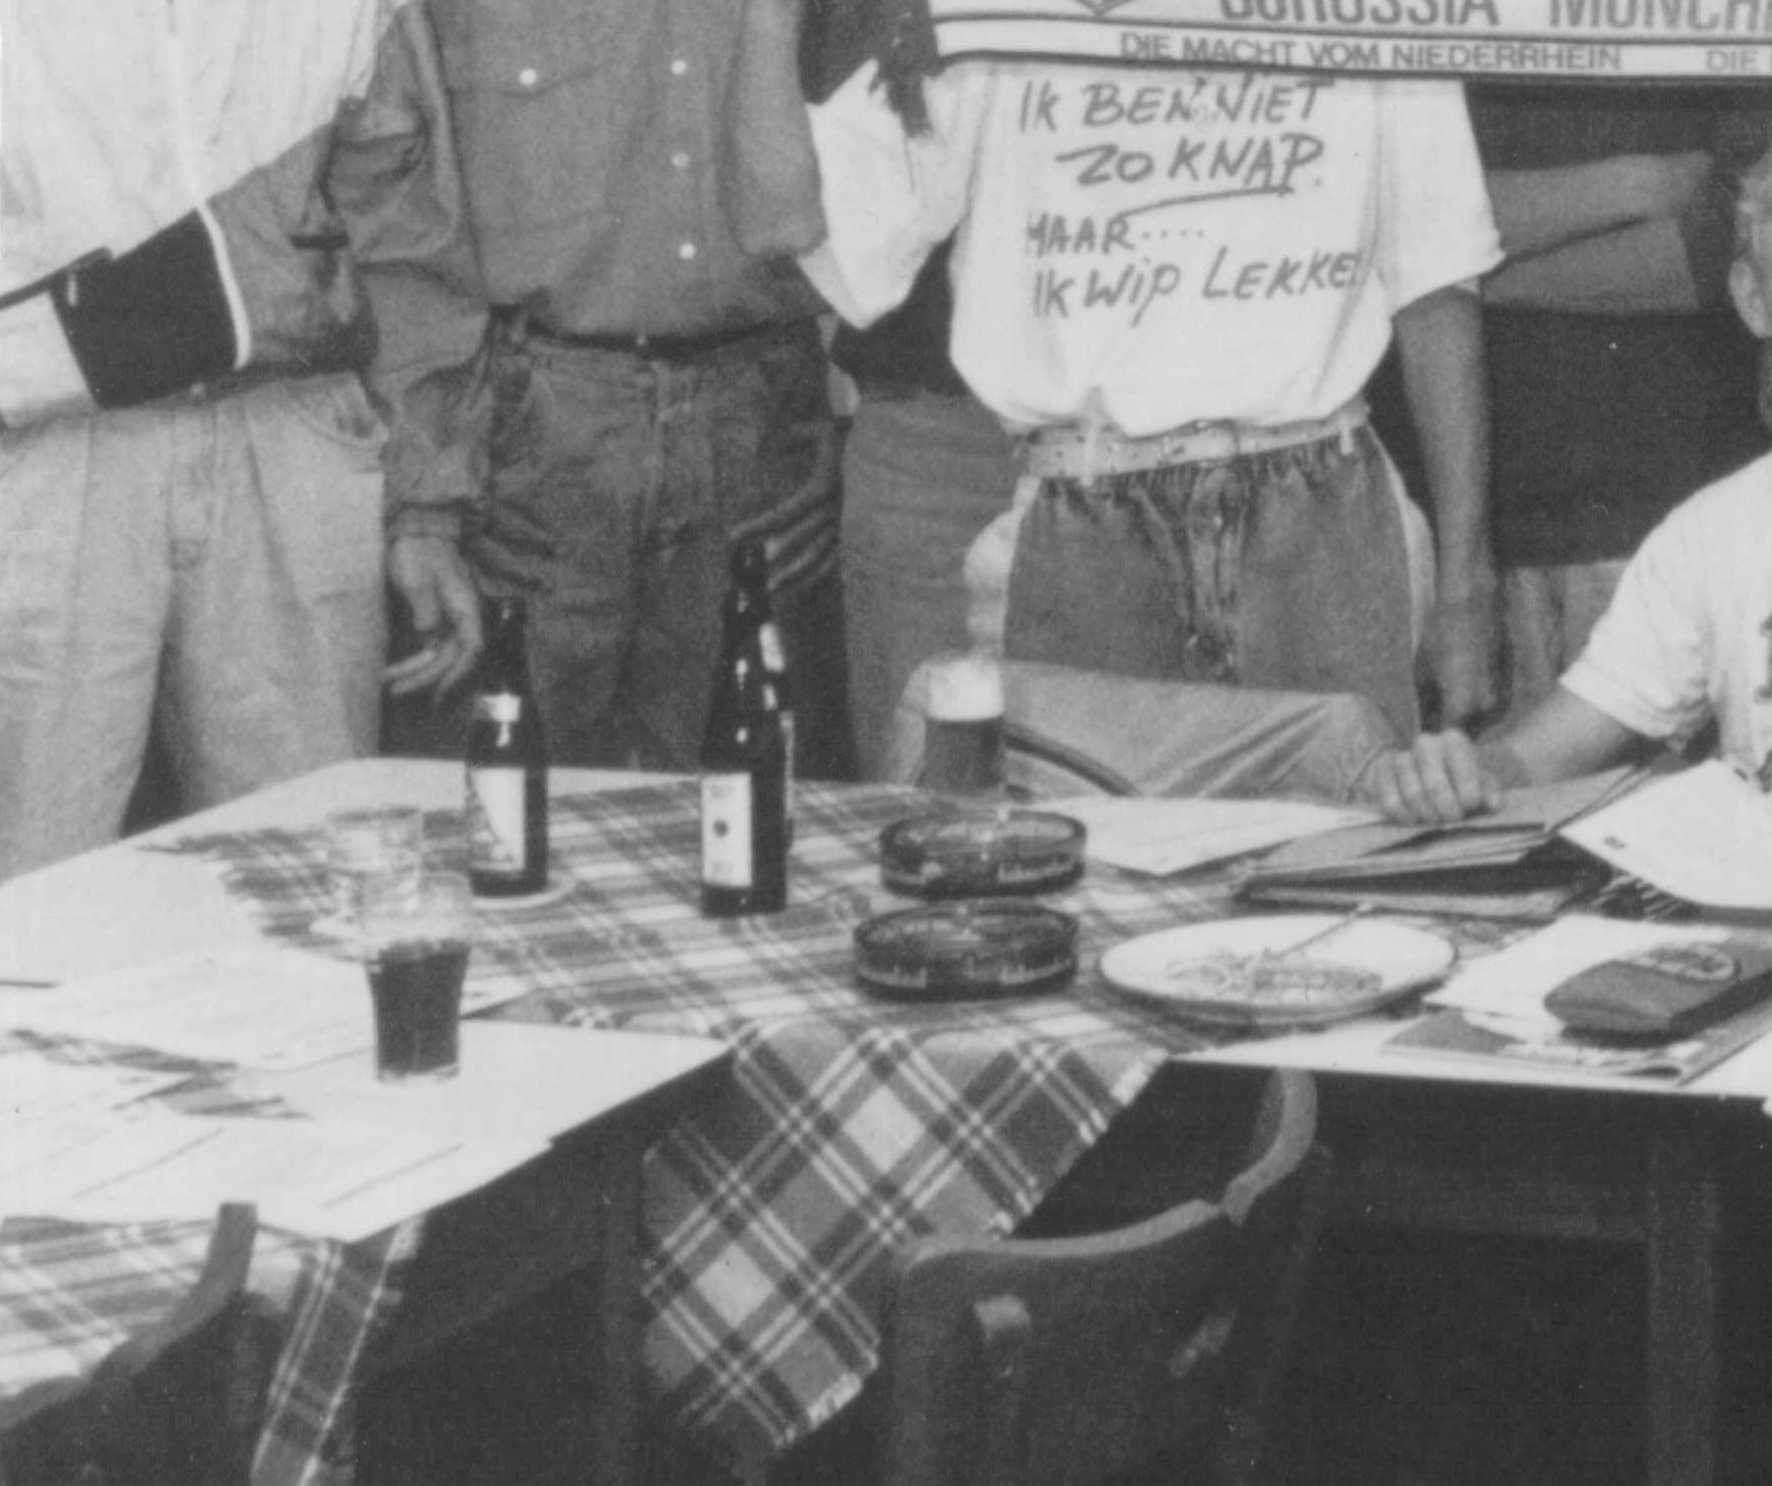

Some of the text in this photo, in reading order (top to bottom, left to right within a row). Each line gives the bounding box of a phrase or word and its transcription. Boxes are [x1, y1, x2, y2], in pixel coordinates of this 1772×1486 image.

[1120, 32, 1621, 71] DIE MACHT VOM NIEDERRHEIN
[1706, 48, 1760, 74] DIE
[1056, 143, 1153, 185] ZO
